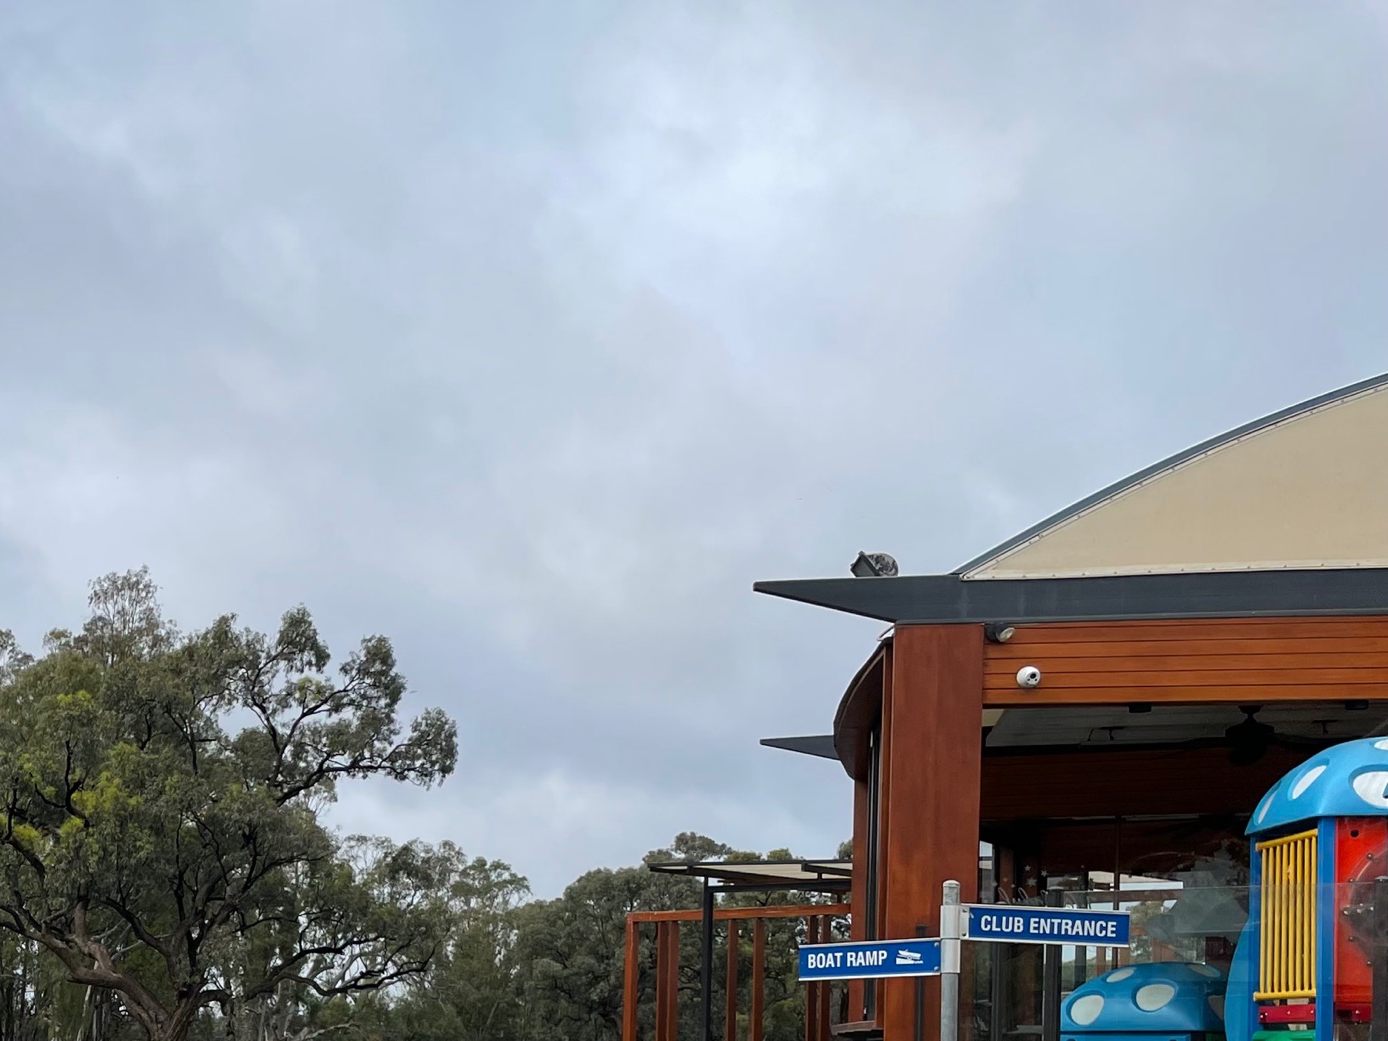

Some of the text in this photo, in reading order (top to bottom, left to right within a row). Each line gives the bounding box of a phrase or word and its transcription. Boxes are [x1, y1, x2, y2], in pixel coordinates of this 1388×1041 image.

[980, 914, 1117, 938] CLUB ENTRANCE
[807, 949, 888, 969] BOAT RAMP
